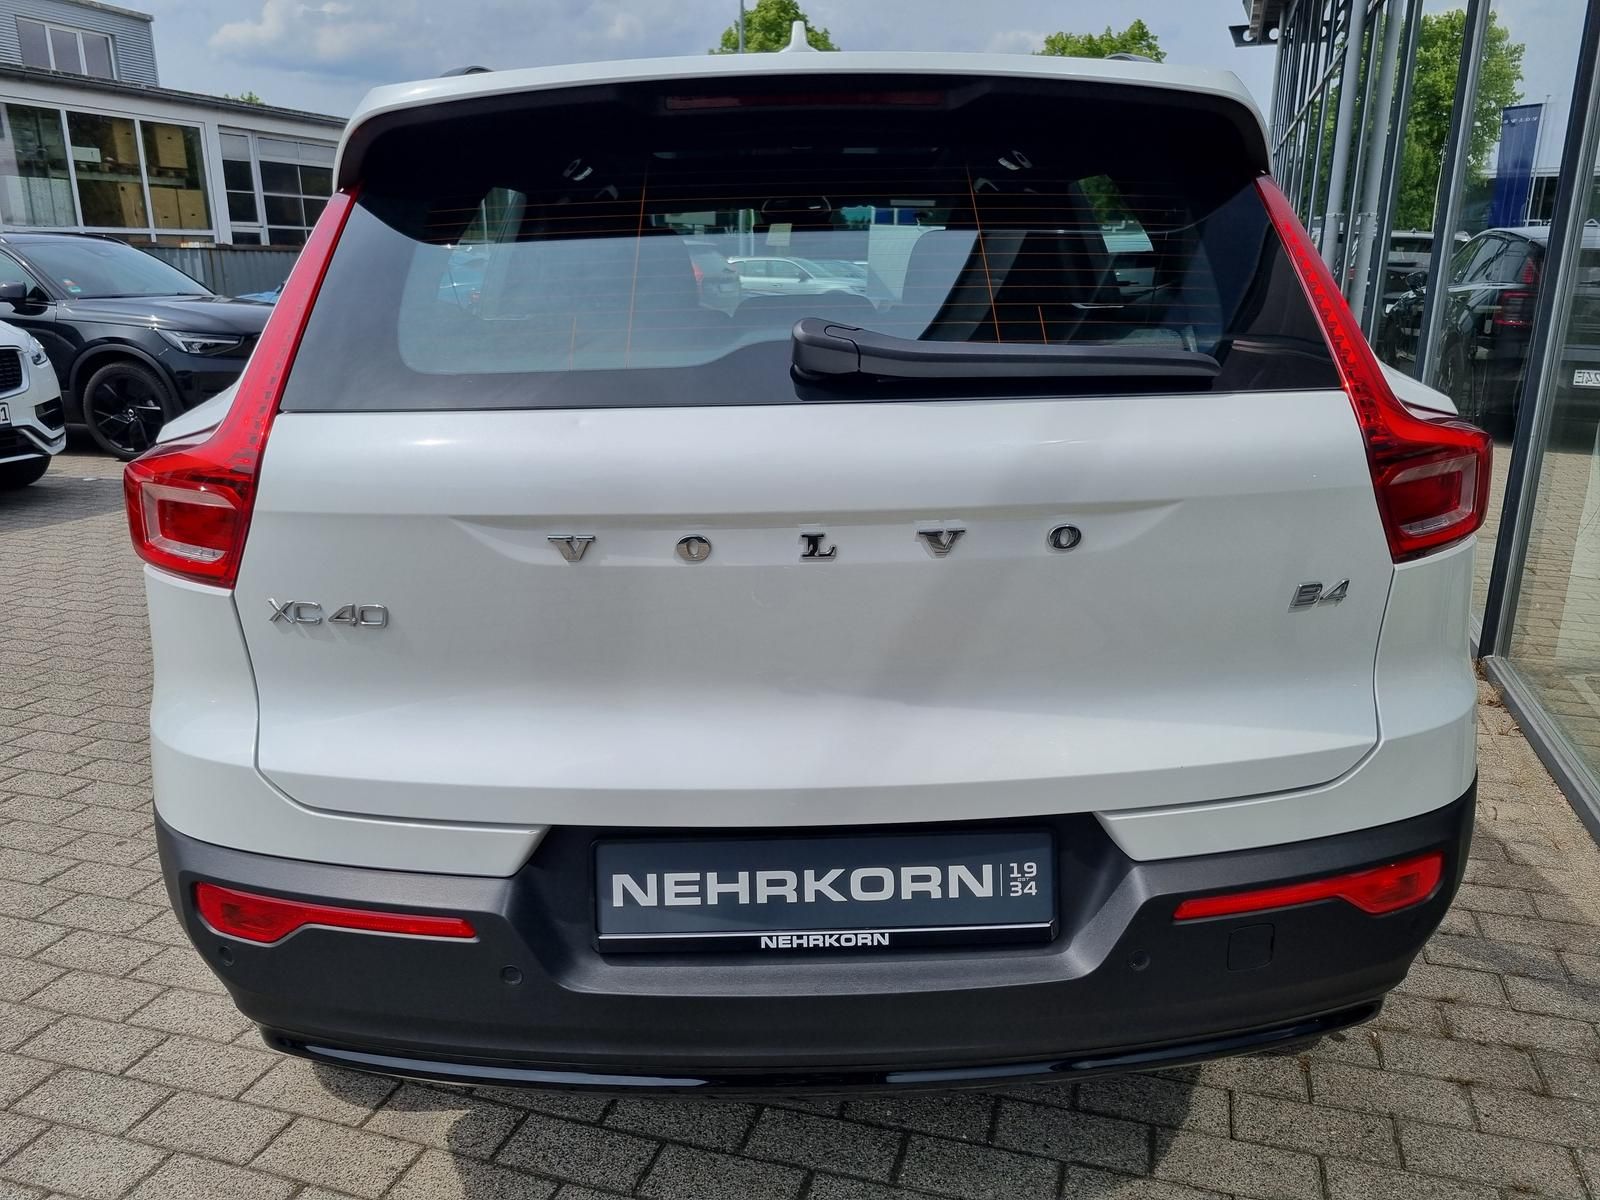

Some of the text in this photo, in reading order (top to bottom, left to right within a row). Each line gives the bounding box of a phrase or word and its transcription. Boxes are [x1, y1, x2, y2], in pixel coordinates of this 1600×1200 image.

[547, 524, 1082, 562] VOLVO
[1289, 579, 1350, 608] B4
[1009, 862, 1037, 878] 19
[612, 864, 993, 907] NEHRKORN
[1009, 881, 1038, 897] 34
[760, 933, 890, 949] NEHRKORN
